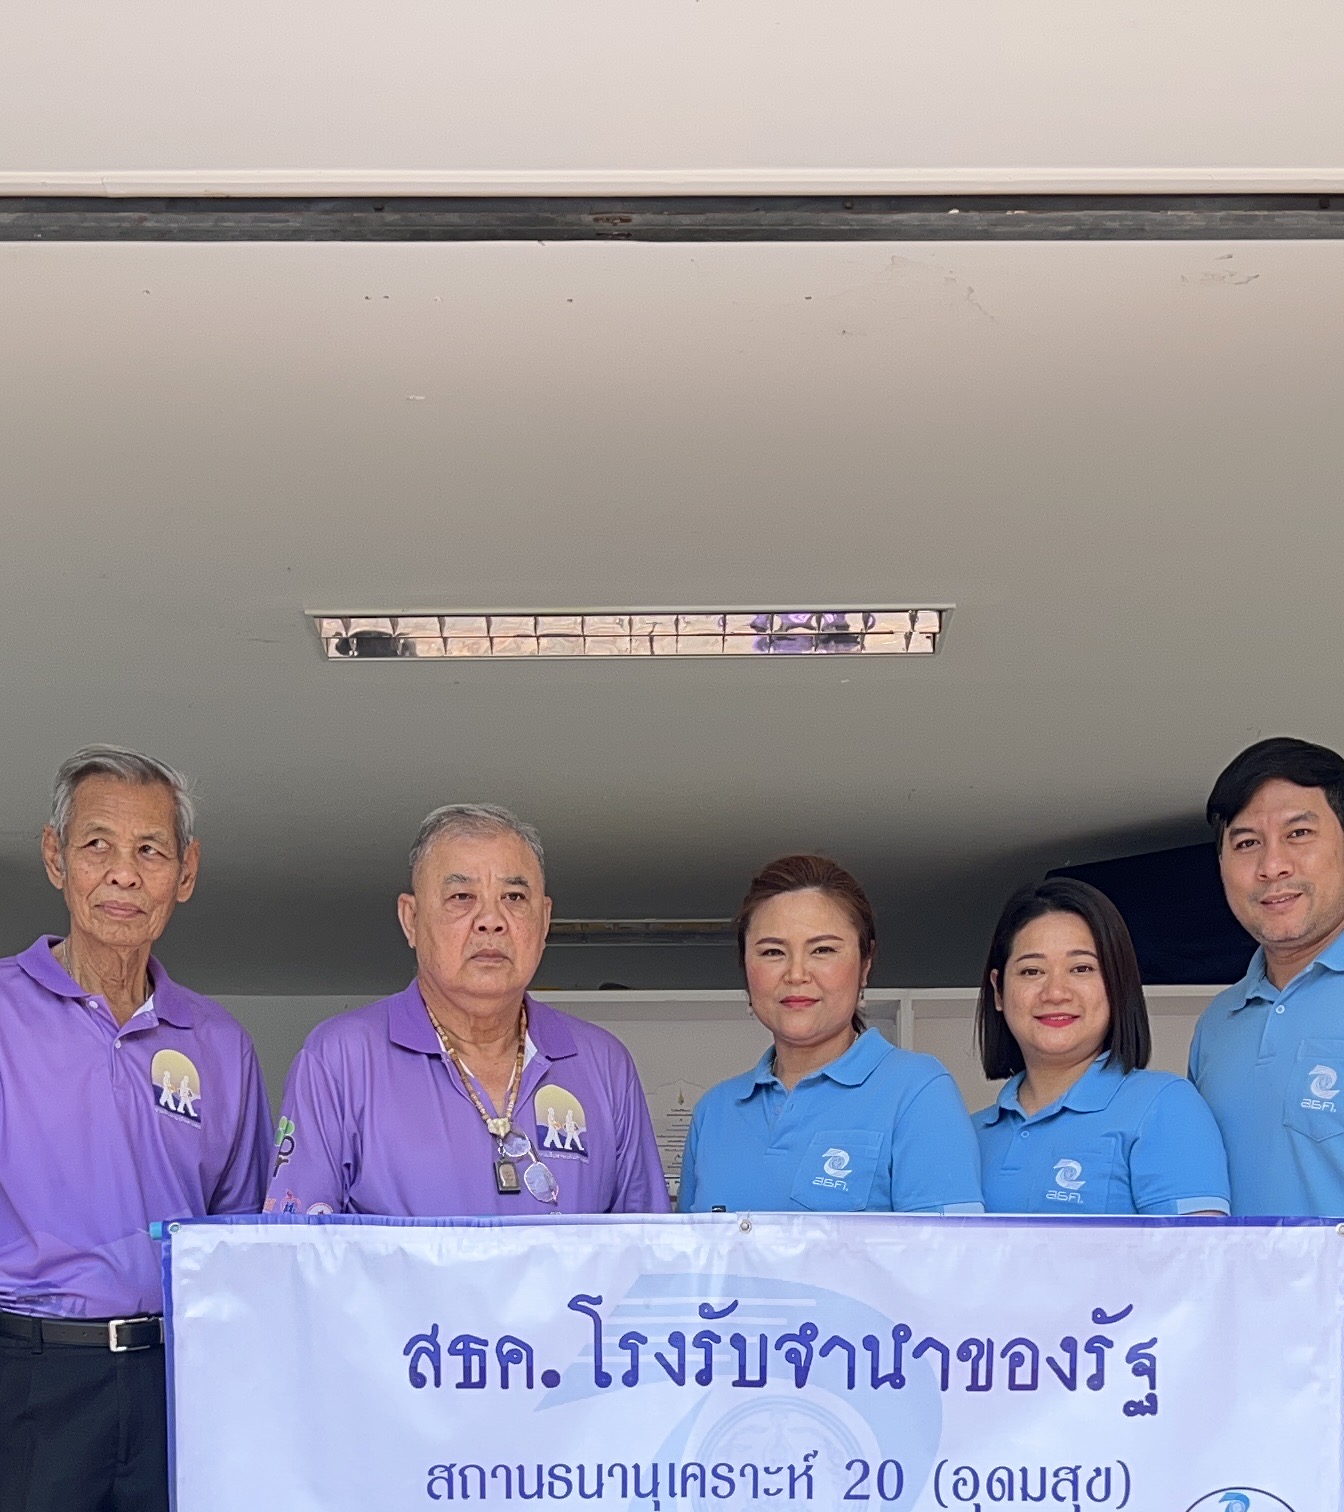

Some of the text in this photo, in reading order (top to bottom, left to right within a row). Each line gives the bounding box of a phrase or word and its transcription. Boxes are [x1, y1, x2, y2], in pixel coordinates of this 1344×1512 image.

[426, 1449, 819, 1512] สถานธนานุเคราะห์
[842, 1458, 904, 1502] 20
